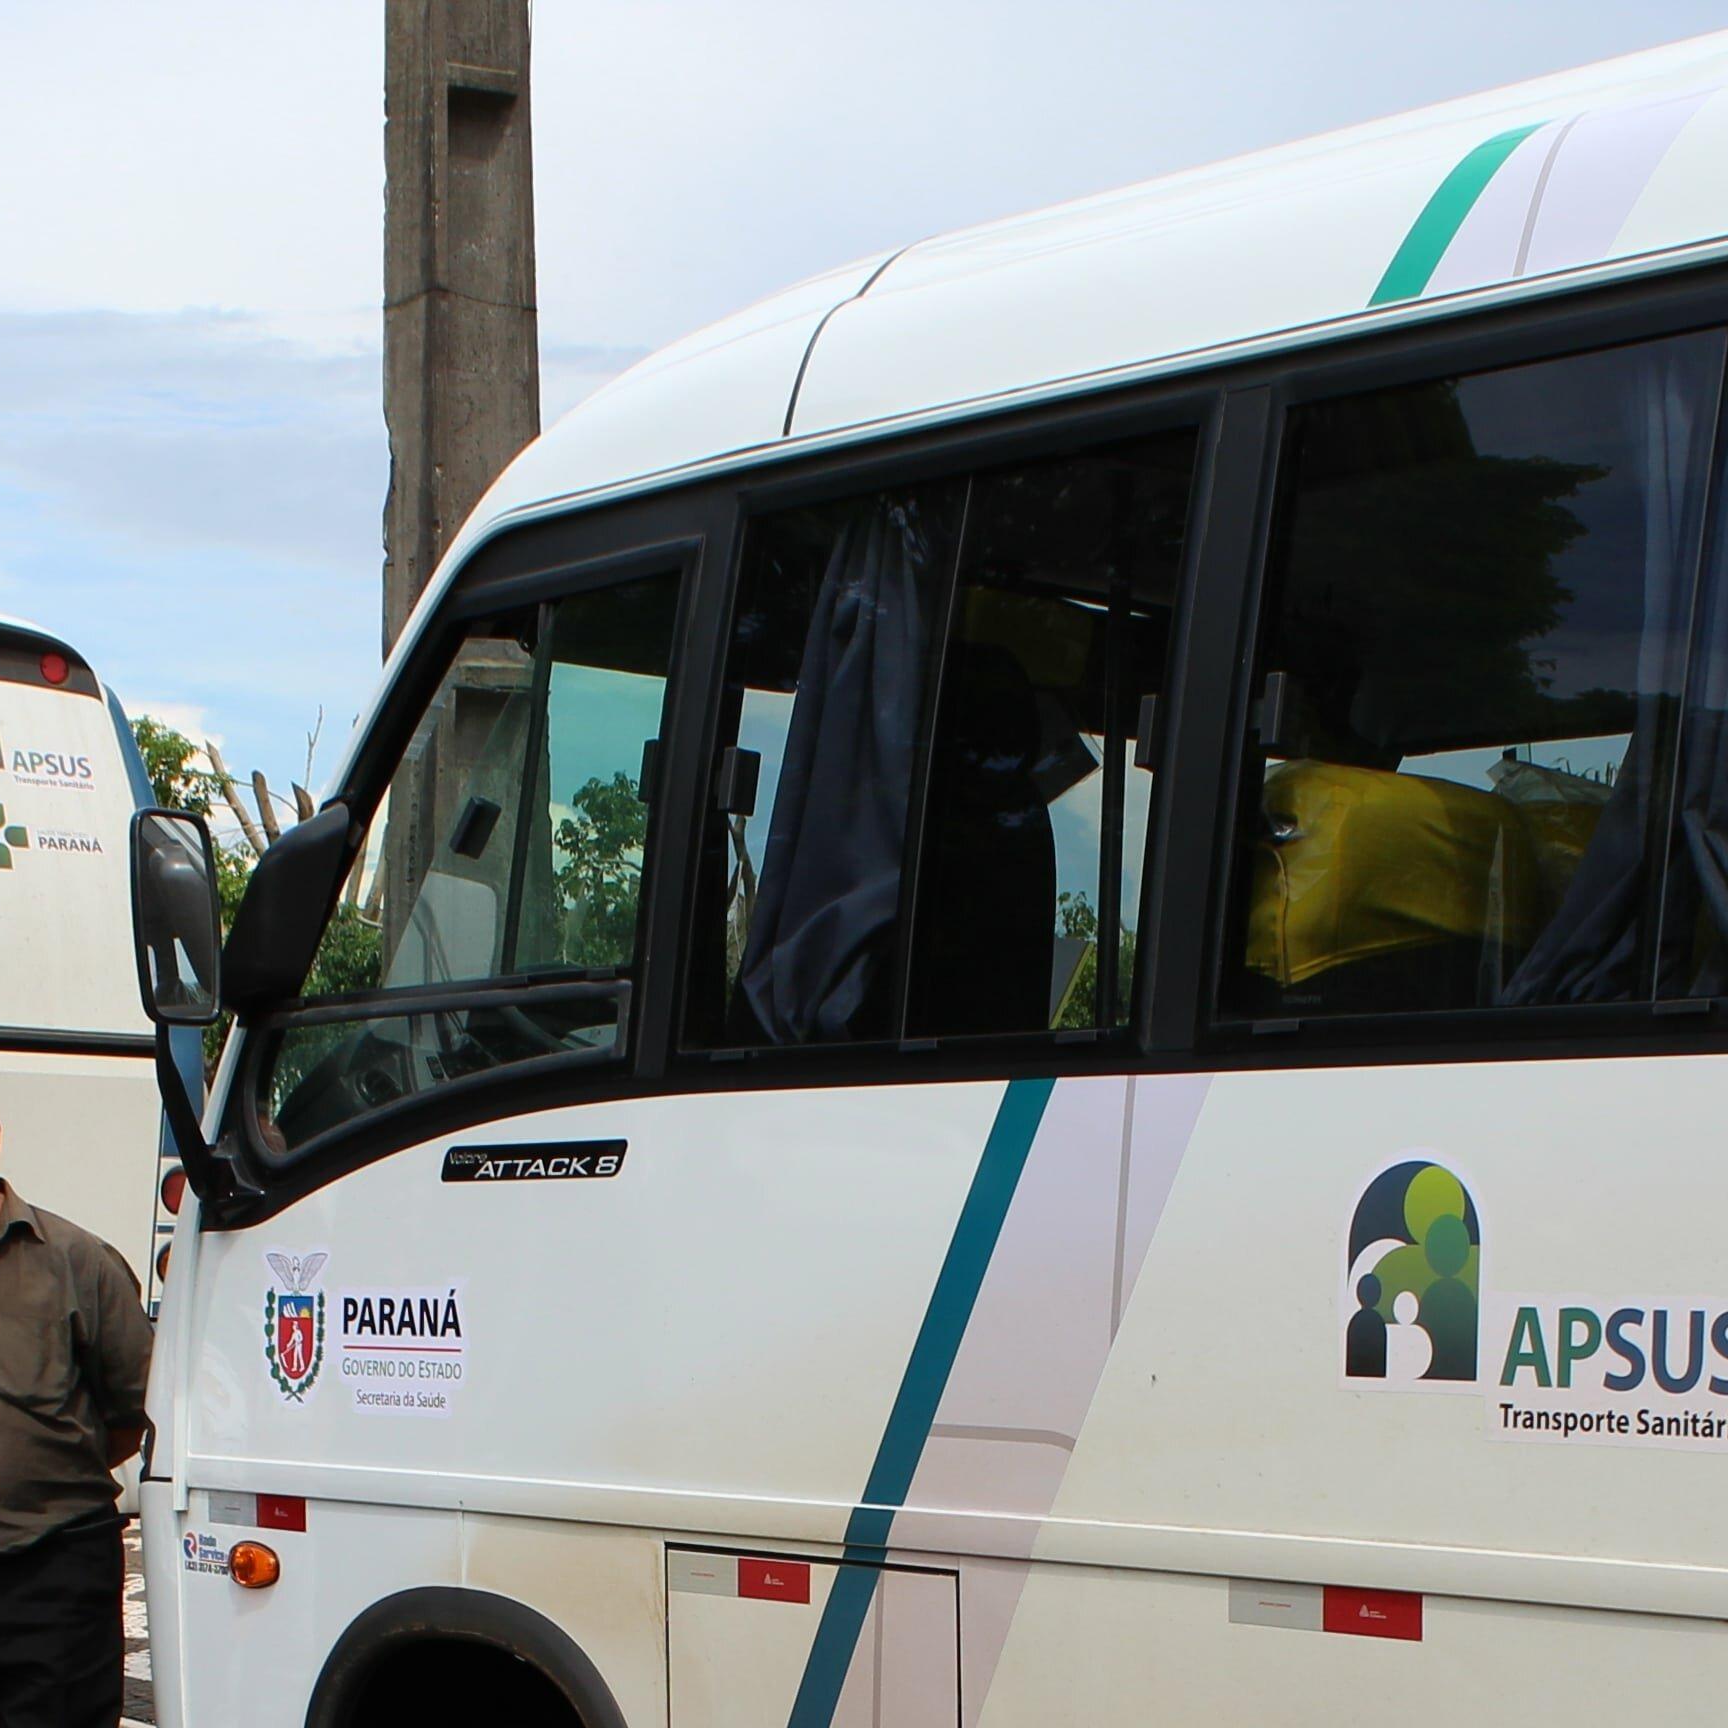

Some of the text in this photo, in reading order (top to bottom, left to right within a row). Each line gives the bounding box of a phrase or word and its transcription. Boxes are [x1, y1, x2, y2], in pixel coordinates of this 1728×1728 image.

[12, 750, 92, 779] APSUS
[38, 835, 103, 854] PARANÁ
[474, 1155, 620, 1178] ATTACK 8
[342, 1288, 462, 1338] PARANÁ
[342, 1357, 462, 1380] GOVERNO DO ESTADO
[356, 1388, 447, 1409] Secretaria da Saúde
[1499, 1403, 1630, 1438] Transporte
